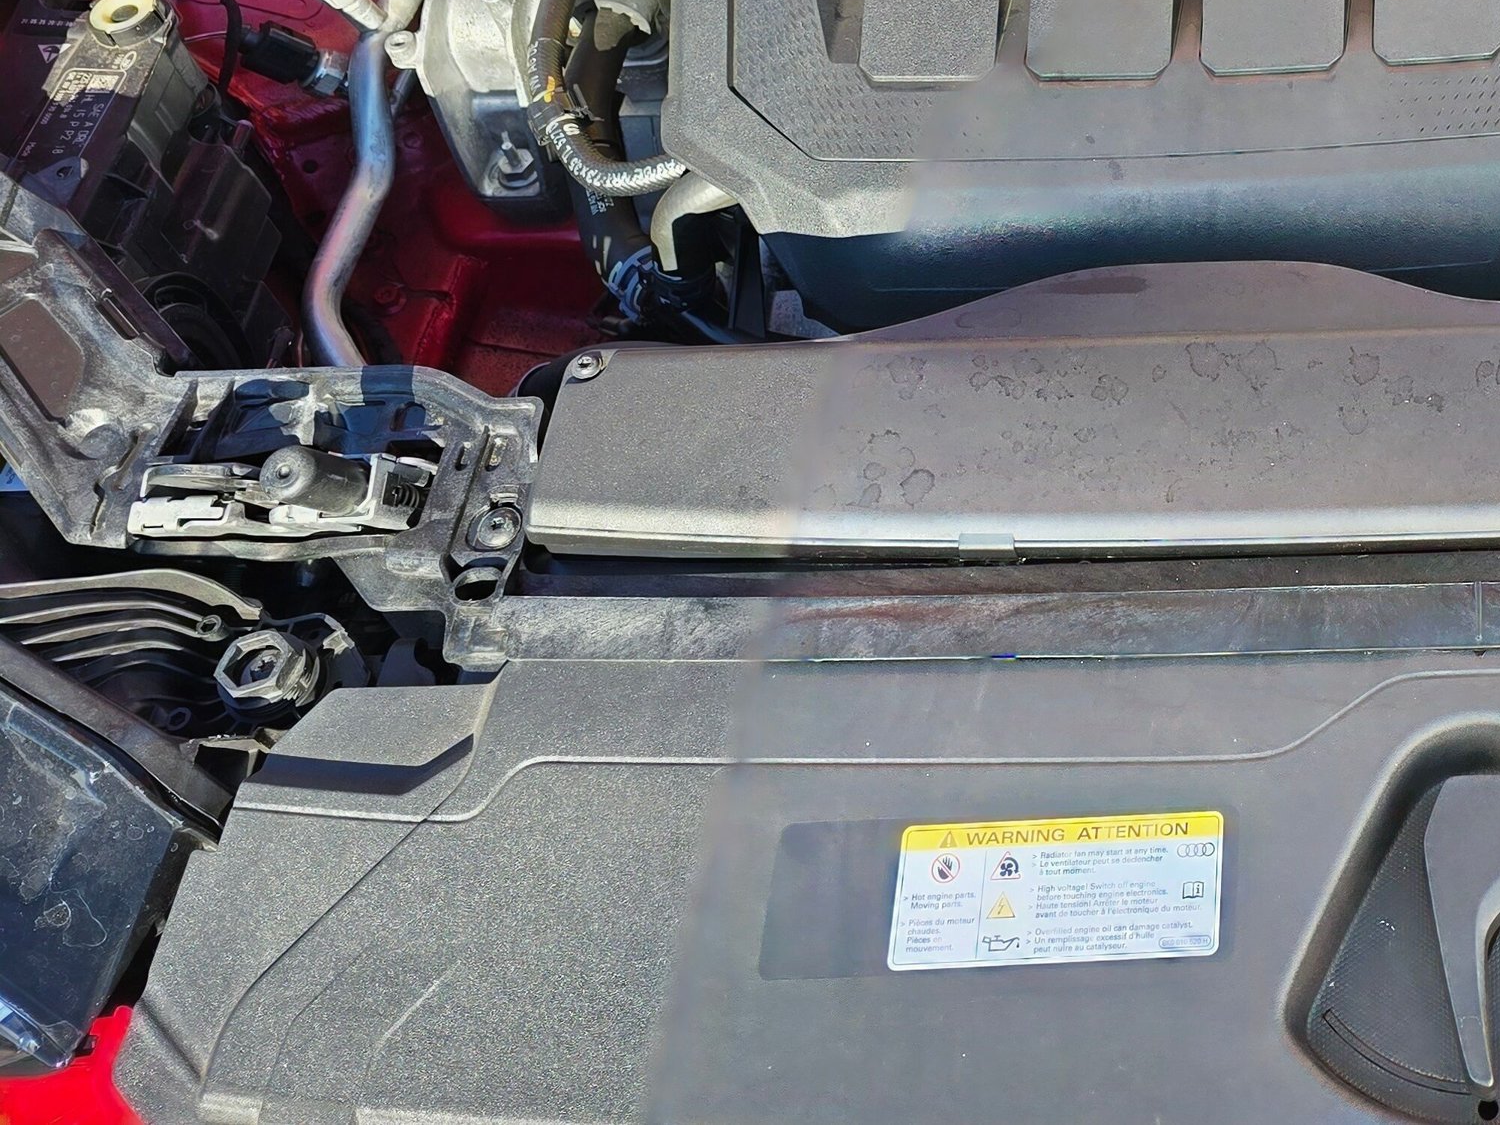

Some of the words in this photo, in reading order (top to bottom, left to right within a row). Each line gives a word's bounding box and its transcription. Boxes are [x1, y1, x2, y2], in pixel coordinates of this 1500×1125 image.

[73, 108, 84, 118] 15
[967, 828, 1065, 846] WARNING
[1076, 822, 1188, 841] ATTENTION
[1041, 851, 1072, 860] Radiator
[1074, 850, 1086, 858] fan
[1088, 850, 1105, 859] may
[1106, 848, 1123, 856] start
[1126, 848, 1132, 856] at
[1133, 848, 1148, 857] any
[1149, 846, 1168, 855] time.
[1040, 859, 1048, 868] Le
[1049, 858, 1090, 867] ventilateur
[1045, 868, 1061, 876] tout
[1062, 867, 1096, 875] moment.
[1038, 885, 1055, 895] High
[1057, 883, 1088, 893] voltage!
[1090, 881, 1116, 891] Switch
[1118, 881, 1129, 889] off
[1130, 881, 1155, 890] engine
[911, 894, 926, 902] Hot
[927, 894, 953, 903] engine
[955, 892, 977, 902] parts.
[1037, 892, 1060, 901] before
[1062, 891, 1096, 901] touching
[1098, 891, 1124, 900] engine
[1126, 888, 1168, 897] electronics.
[911, 903, 940, 912] Moving
[941, 901, 963, 911] parts.
[1036, 902, 1058, 910] Haute
[1060, 900, 1091, 909] tension!
[1121, 898, 1128, 906] le
[1130, 897, 1158, 905] moteur
[1058, 910, 1068, 918] de
[1069, 908, 1099, 916] toucher
[1160, 904, 1170, 912] du
[1172, 903, 1201, 912] moteur.
[909, 918, 933, 927] Pièces
[935, 918, 945, 926] du
[946, 917, 975, 925] moteur
[907, 928, 941, 936] chaudes.
[1034, 928, 1072, 937] Overfilled
[1074, 926, 1100, 936] engine
[1101, 924, 1111, 932] oil
[1128, 923, 1160, 933] damage
[1161, 921, 1193, 931] catalyst.
[906, 936, 931, 945] Pièces
[1034, 936, 1046, 944] Un
[1047, 935, 1094, 945] remplissage
[1096, 933, 1126, 942] excessif
[1128, 931, 1154, 940] d'huile
[905, 945, 953, 954] mouvement.
[1033, 946, 1051, 955] peut
[1053, 944, 1073, 952] nuire
[1087, 942, 1127, 951] catalyseur.
